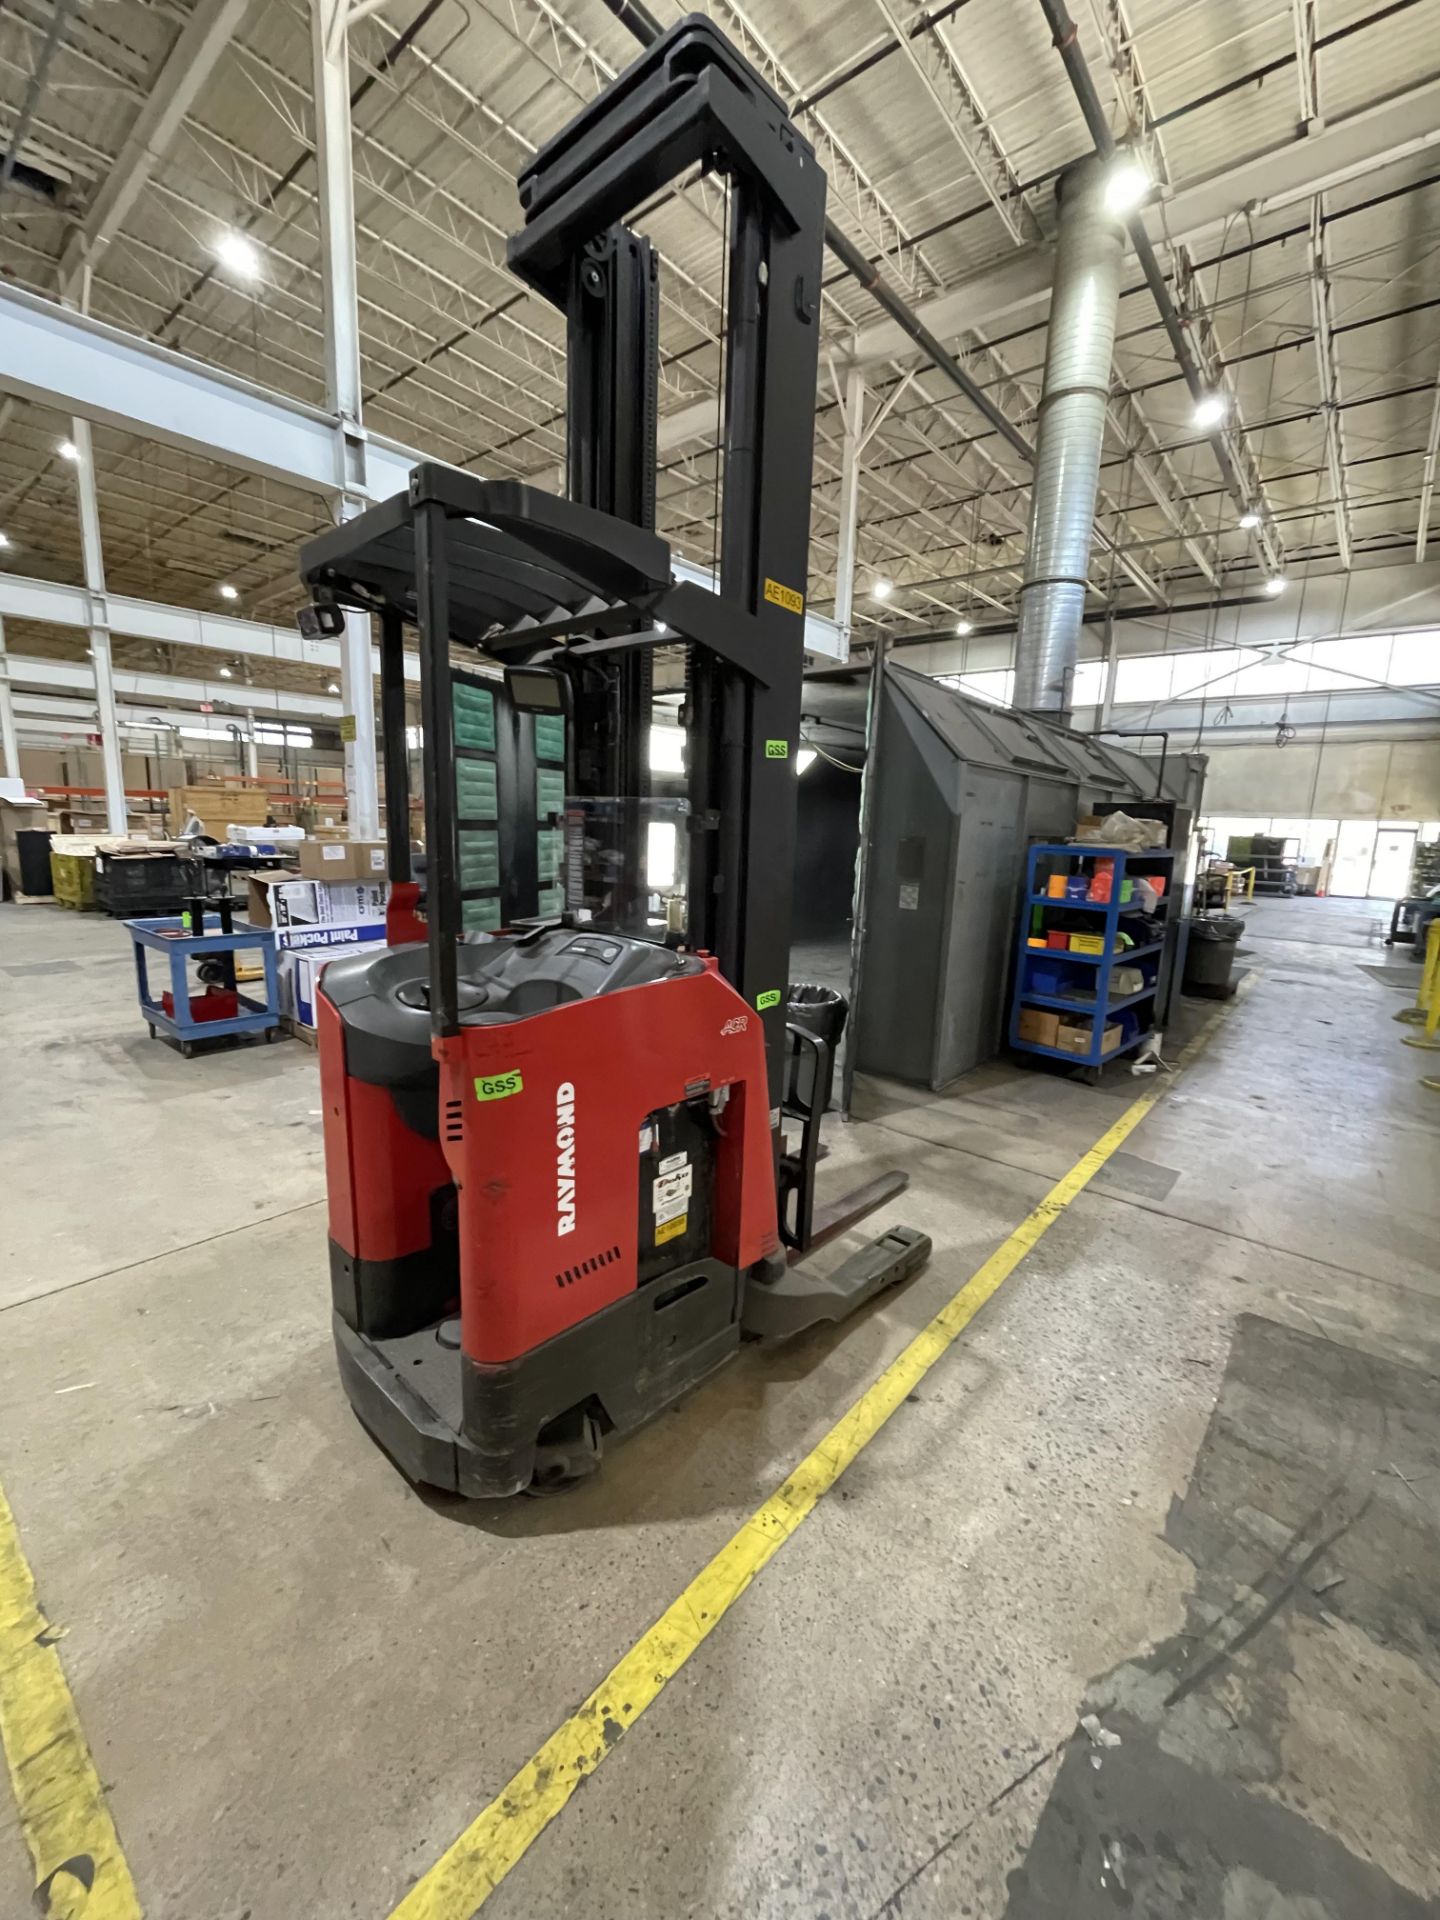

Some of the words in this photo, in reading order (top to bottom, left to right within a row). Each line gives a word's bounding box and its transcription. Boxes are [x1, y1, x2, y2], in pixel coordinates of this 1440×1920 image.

[767, 744, 786, 757] GSS
[329, 928, 359, 943] Paint
[760, 993, 777, 1005] GSS
[482, 1077, 516, 1095] GSS
[556, 1081, 576, 1237] RAYMOND
